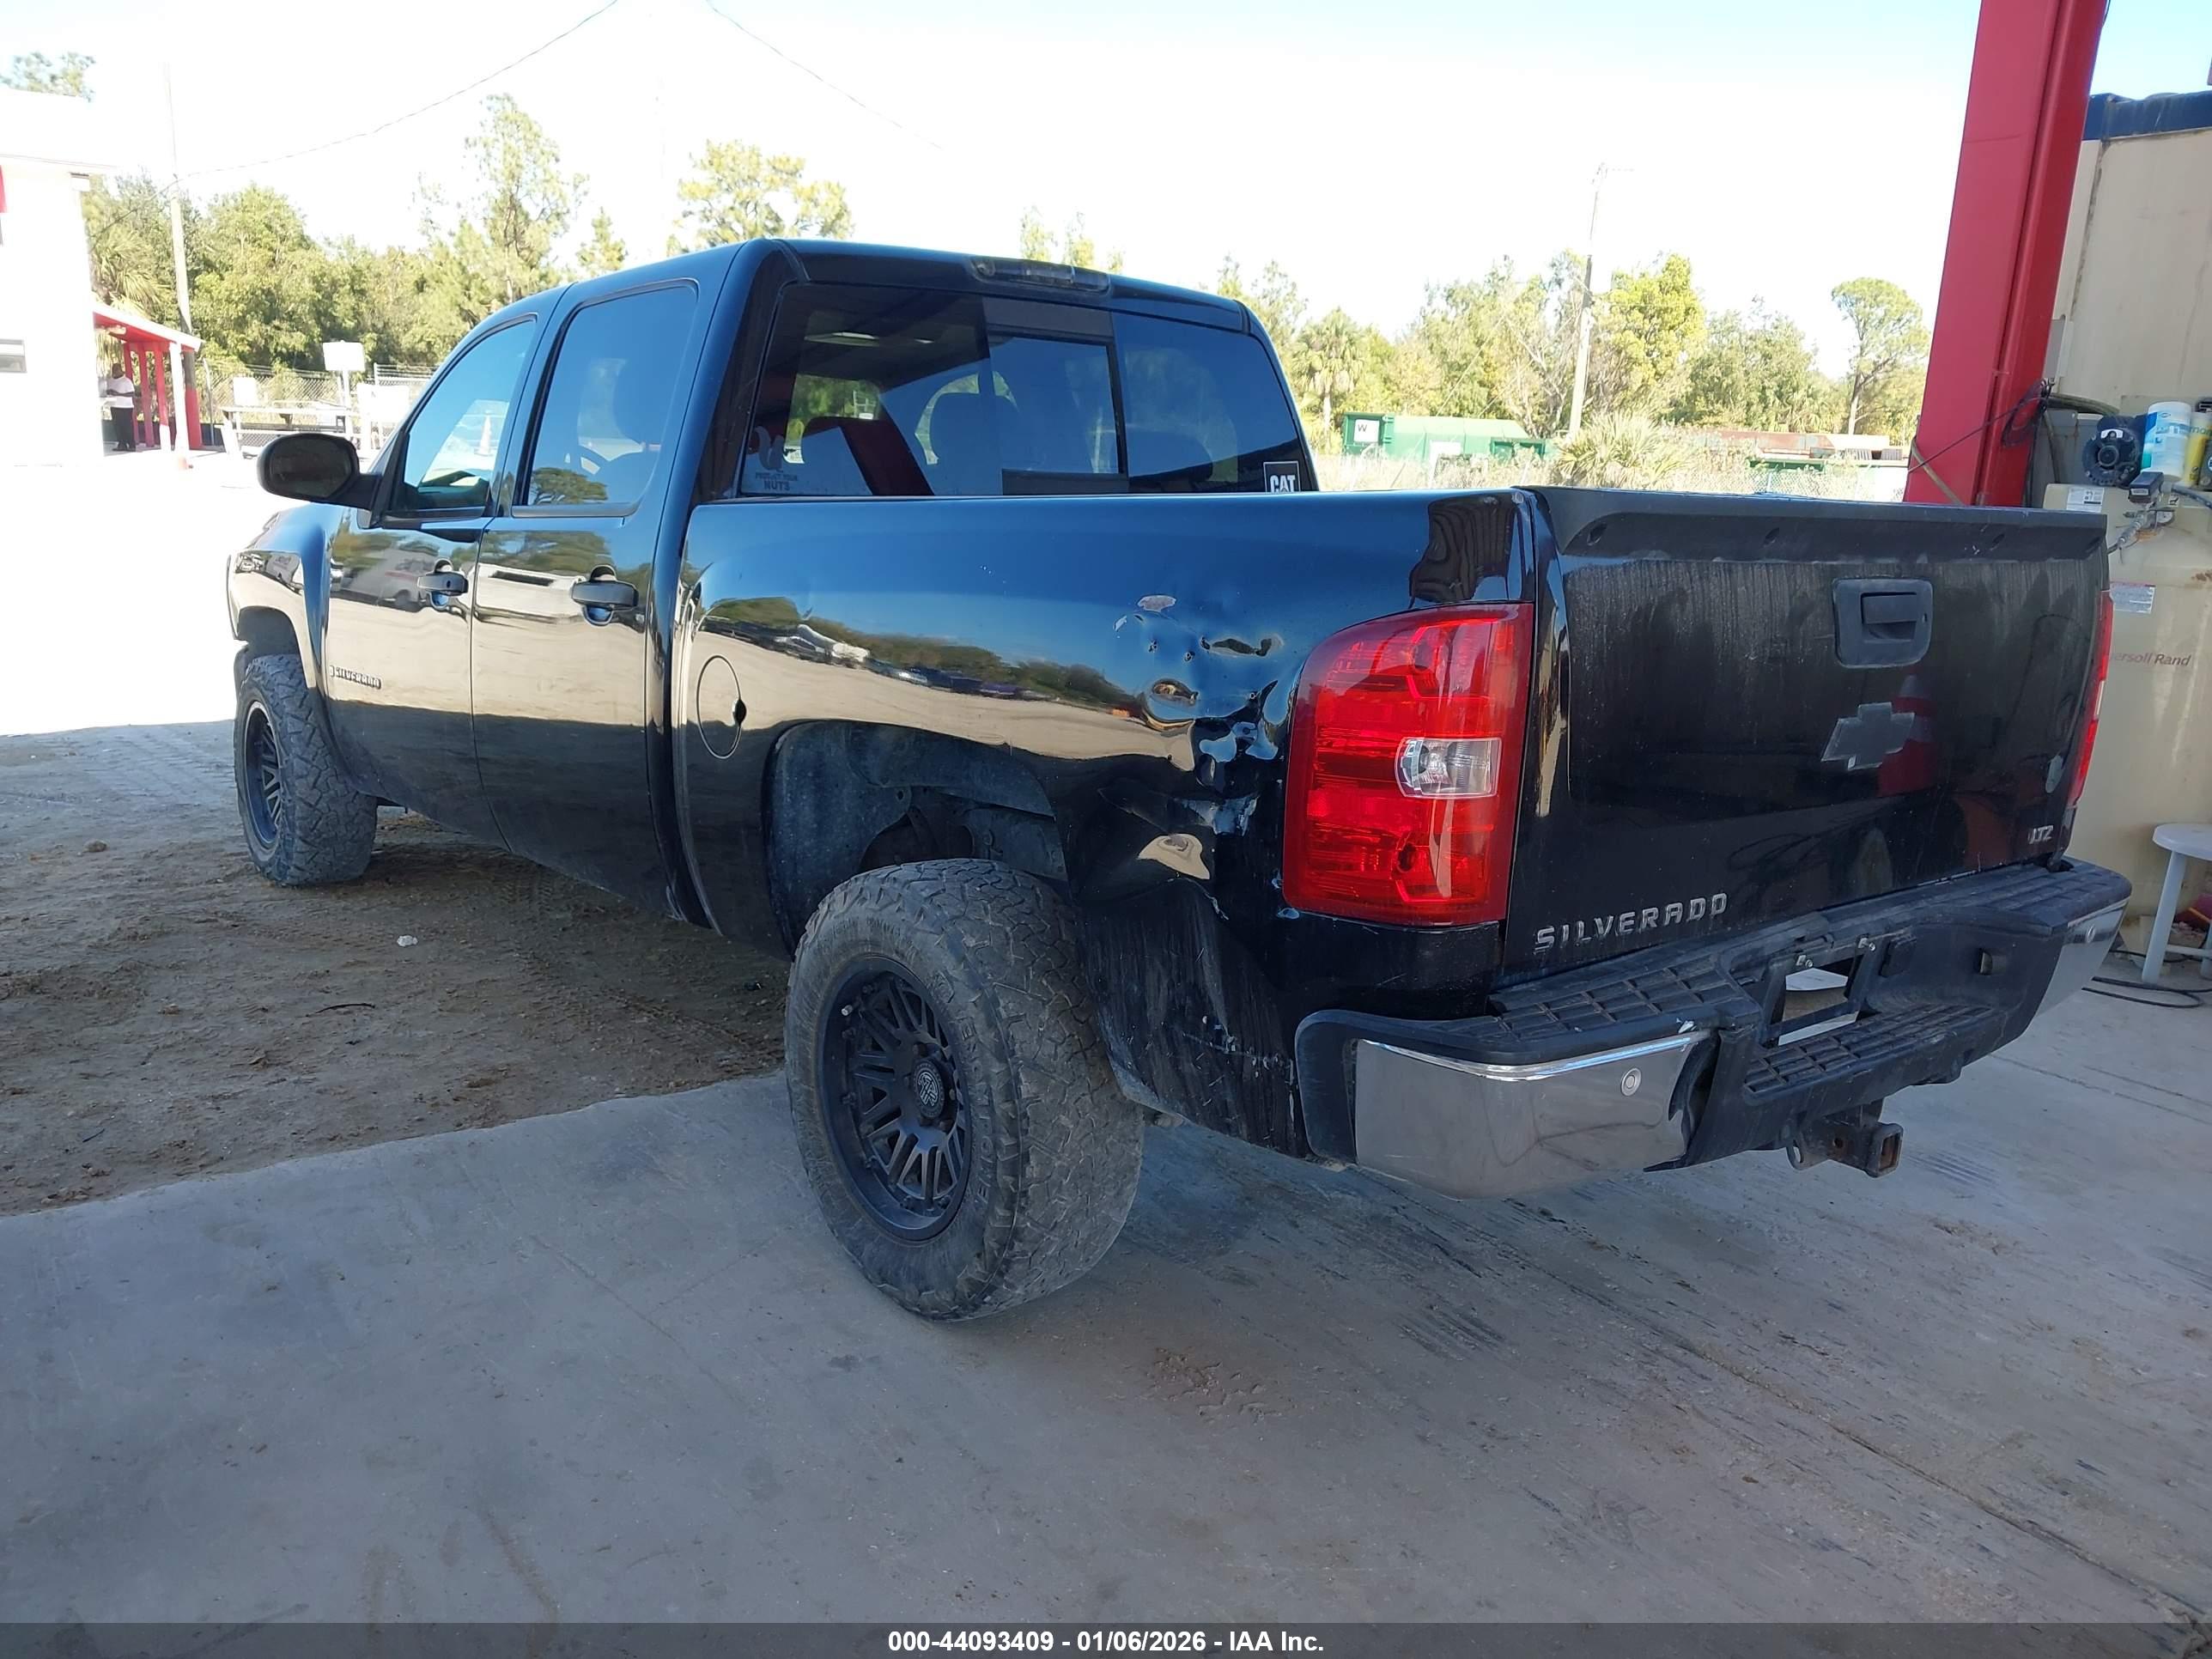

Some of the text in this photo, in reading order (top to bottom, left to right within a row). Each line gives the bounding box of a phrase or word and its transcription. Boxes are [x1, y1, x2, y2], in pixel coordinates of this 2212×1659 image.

[1269, 474, 1297, 494] CAT
[2154, 653, 2192, 666] Rand
[2028, 824, 2054, 845] LTZ
[1533, 892, 1729, 955] SILVERADO
